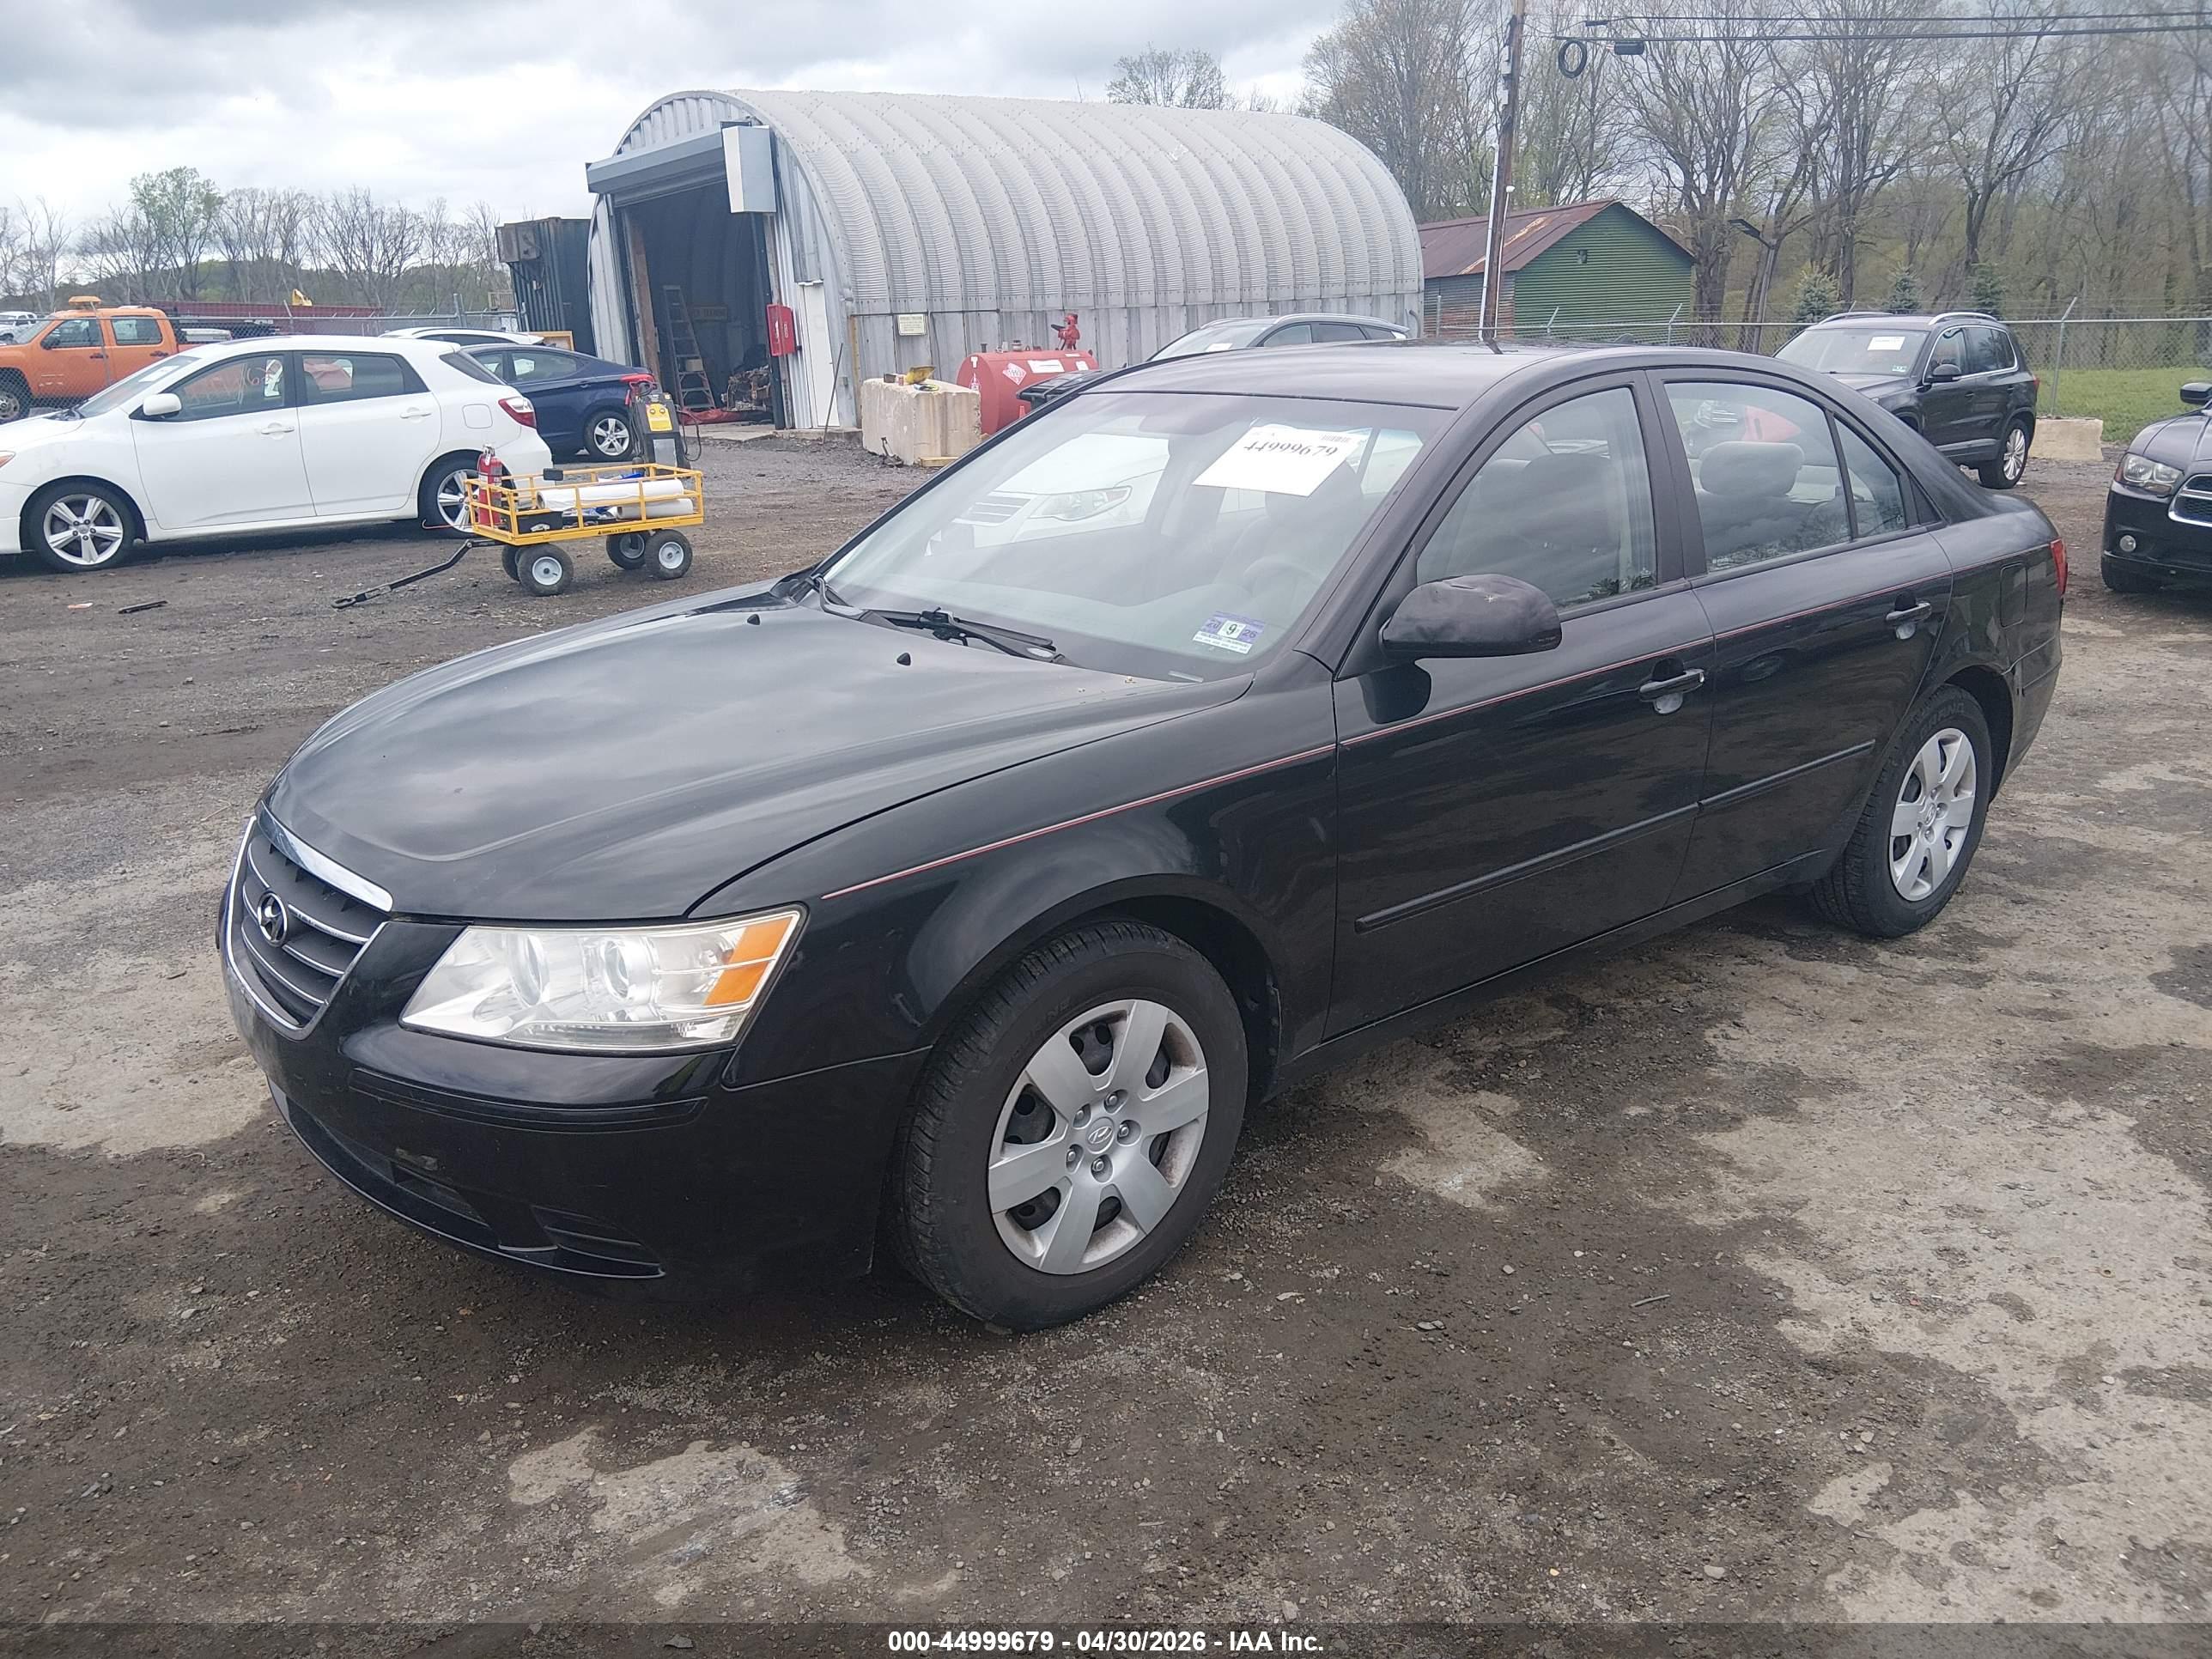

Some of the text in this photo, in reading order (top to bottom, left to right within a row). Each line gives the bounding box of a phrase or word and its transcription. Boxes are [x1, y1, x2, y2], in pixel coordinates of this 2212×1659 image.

[1243, 440, 1339, 457] 44999679
[1225, 623, 1238, 635] 9
[1242, 629, 1258, 639] 26
